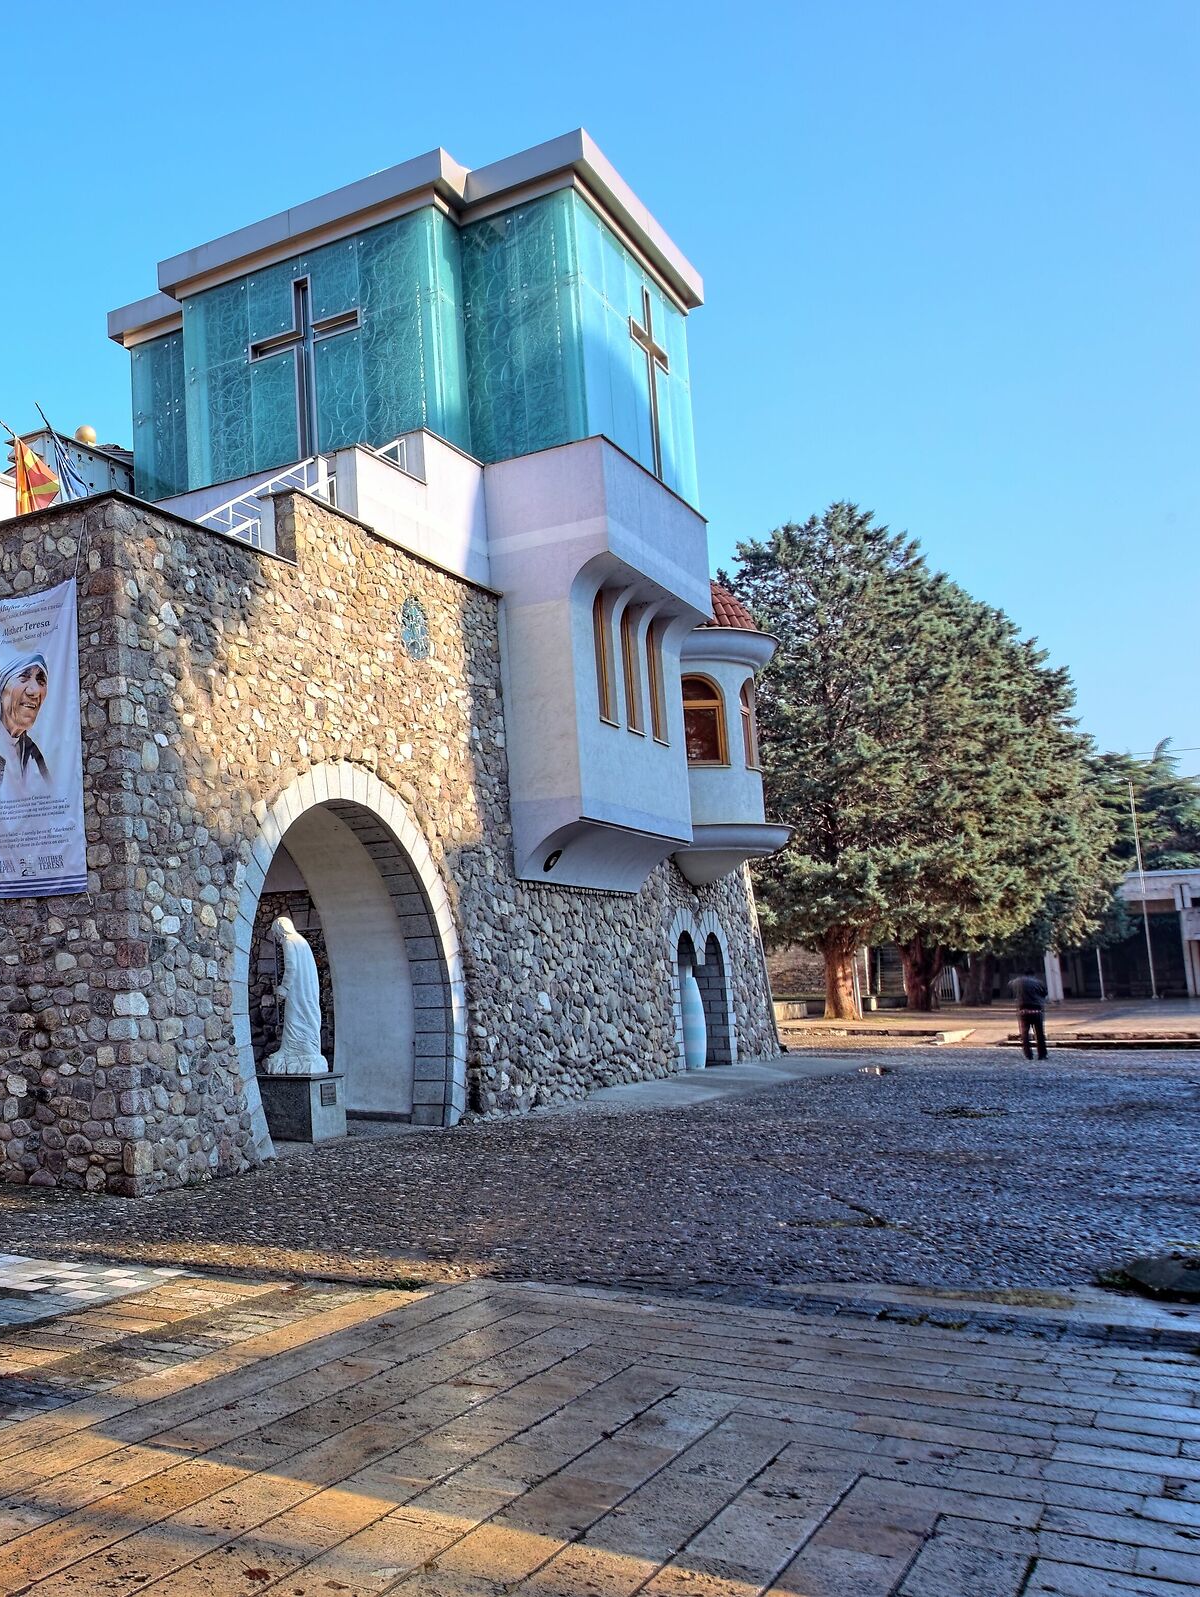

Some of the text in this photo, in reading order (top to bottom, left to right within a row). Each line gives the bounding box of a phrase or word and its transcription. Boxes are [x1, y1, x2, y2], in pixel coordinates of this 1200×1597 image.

[2, 626, 23, 636] Mother
[24, 620, 50, 631] Teresa
[38, 855, 64, 864] MOTHER
[38, 861, 65, 870] TERESA
